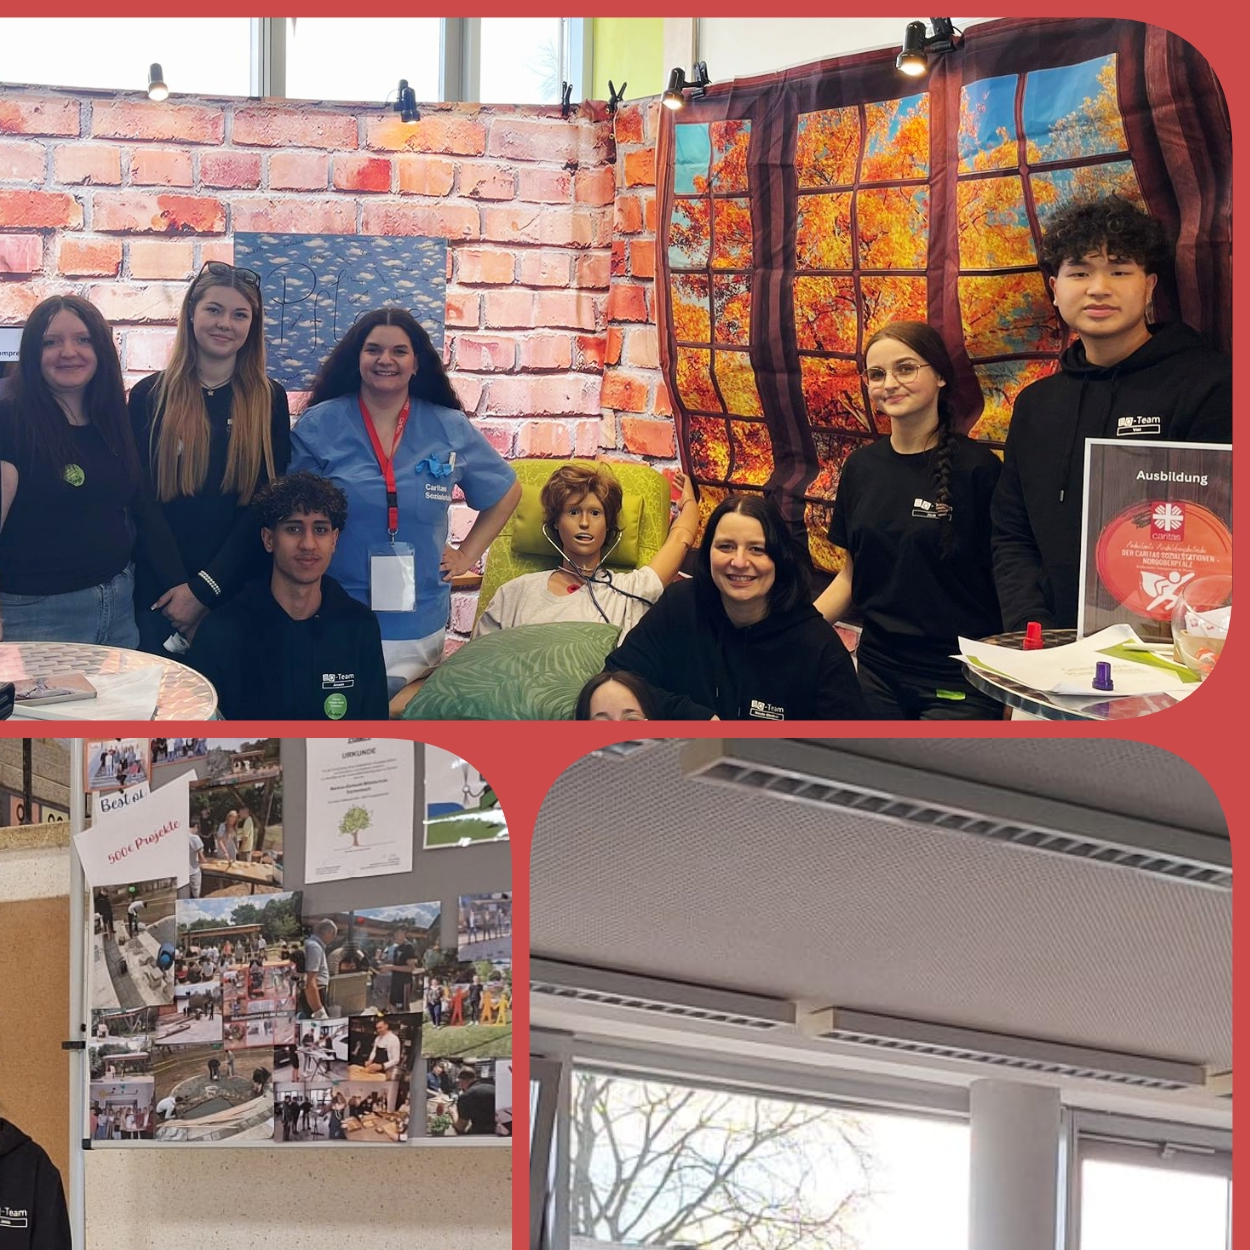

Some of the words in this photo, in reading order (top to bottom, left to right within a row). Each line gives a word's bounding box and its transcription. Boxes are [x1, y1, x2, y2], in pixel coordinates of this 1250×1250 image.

[1136, 470, 1208, 486] Ausbildung
[425, 484, 447, 492] Caritas
[1135, 550, 1160, 558] CARITAS
[1161, 552, 1215, 562] SOZIALSTATIONEN
[342, 748, 376, 759] URKUNDE
[100, 793, 128, 812] Best
[135, 820, 179, 850] Projekte
